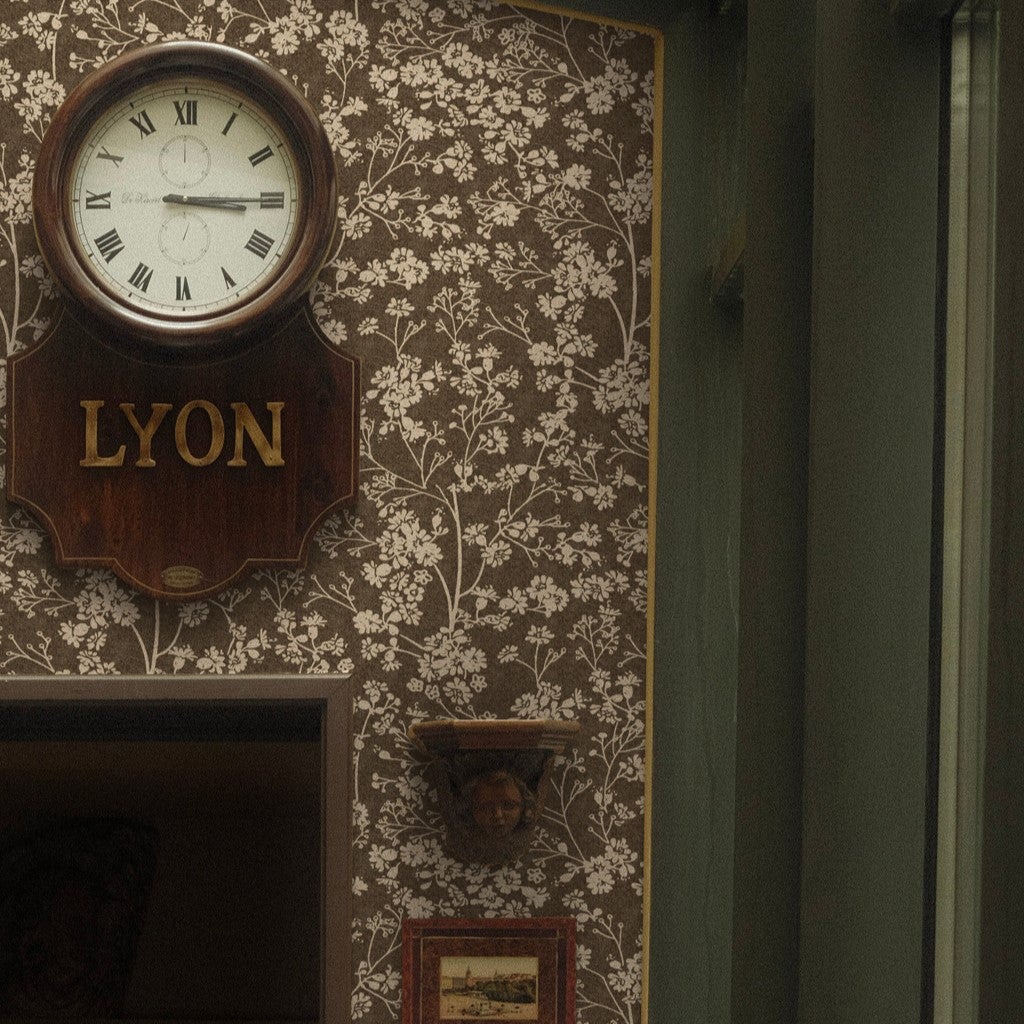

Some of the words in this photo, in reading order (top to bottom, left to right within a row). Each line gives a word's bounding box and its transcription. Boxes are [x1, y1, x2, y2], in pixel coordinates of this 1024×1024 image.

[129, 110, 156, 139] XI
[173, 100, 198, 125] XII
[222, 112, 238, 136] I
[96, 146, 124, 167] X
[248, 145, 274, 167] II
[86, 190, 111, 209] IX
[94, 228, 125, 264] VIII
[244, 229, 275, 260] IIII
[128, 262, 154, 293] VII
[176, 276, 192, 300] VI
[79, 399, 286, 467] LYON
